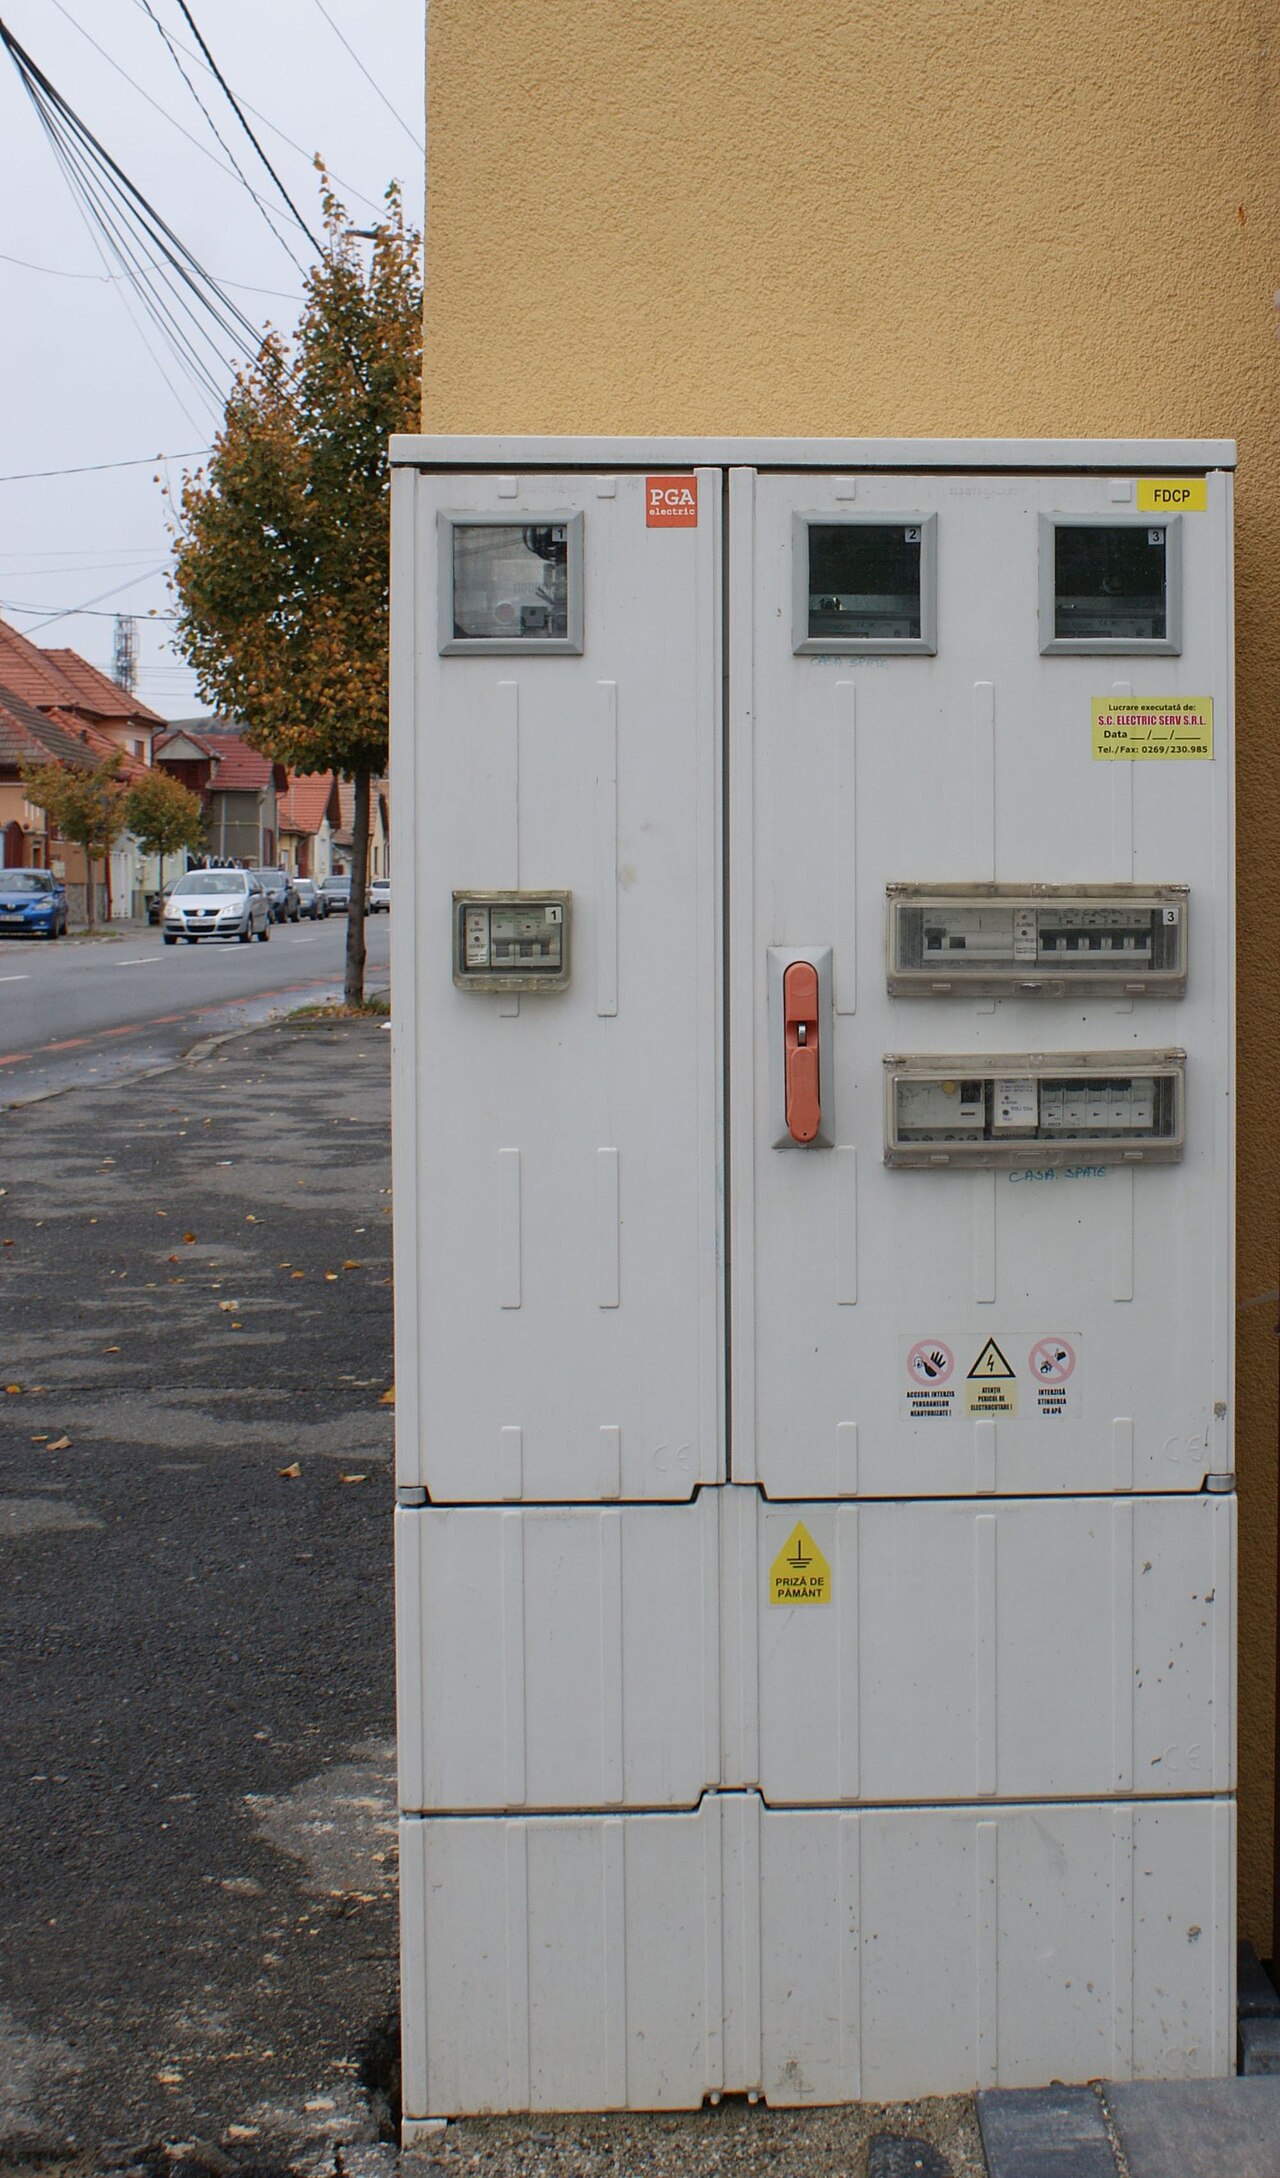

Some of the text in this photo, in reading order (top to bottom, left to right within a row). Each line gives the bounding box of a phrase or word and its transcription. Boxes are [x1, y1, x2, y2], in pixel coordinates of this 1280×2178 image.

[650, 489, 695, 505] PGA
[1154, 489, 1190, 502] FDCP
[649, 507, 695, 516] electric
[558, 528, 563, 539] 1
[909, 529, 917, 540] 2
[1152, 531, 1160, 542] 3
[1098, 715, 1206, 726] S.C. ELECTRIC SERV S.R.L.
[1103, 730, 1128, 738] Data
[1097, 746, 1208, 754] Tel./Fax: 0269/230.985
[550, 910, 556, 920] 1
[1167, 911, 1175, 922] 3
[1065, 1166, 1106, 1179] SPATE
[775, 1576, 825, 1586] PRIZĂ DE
[778, 1587, 823, 1598] PĂMÂNT
